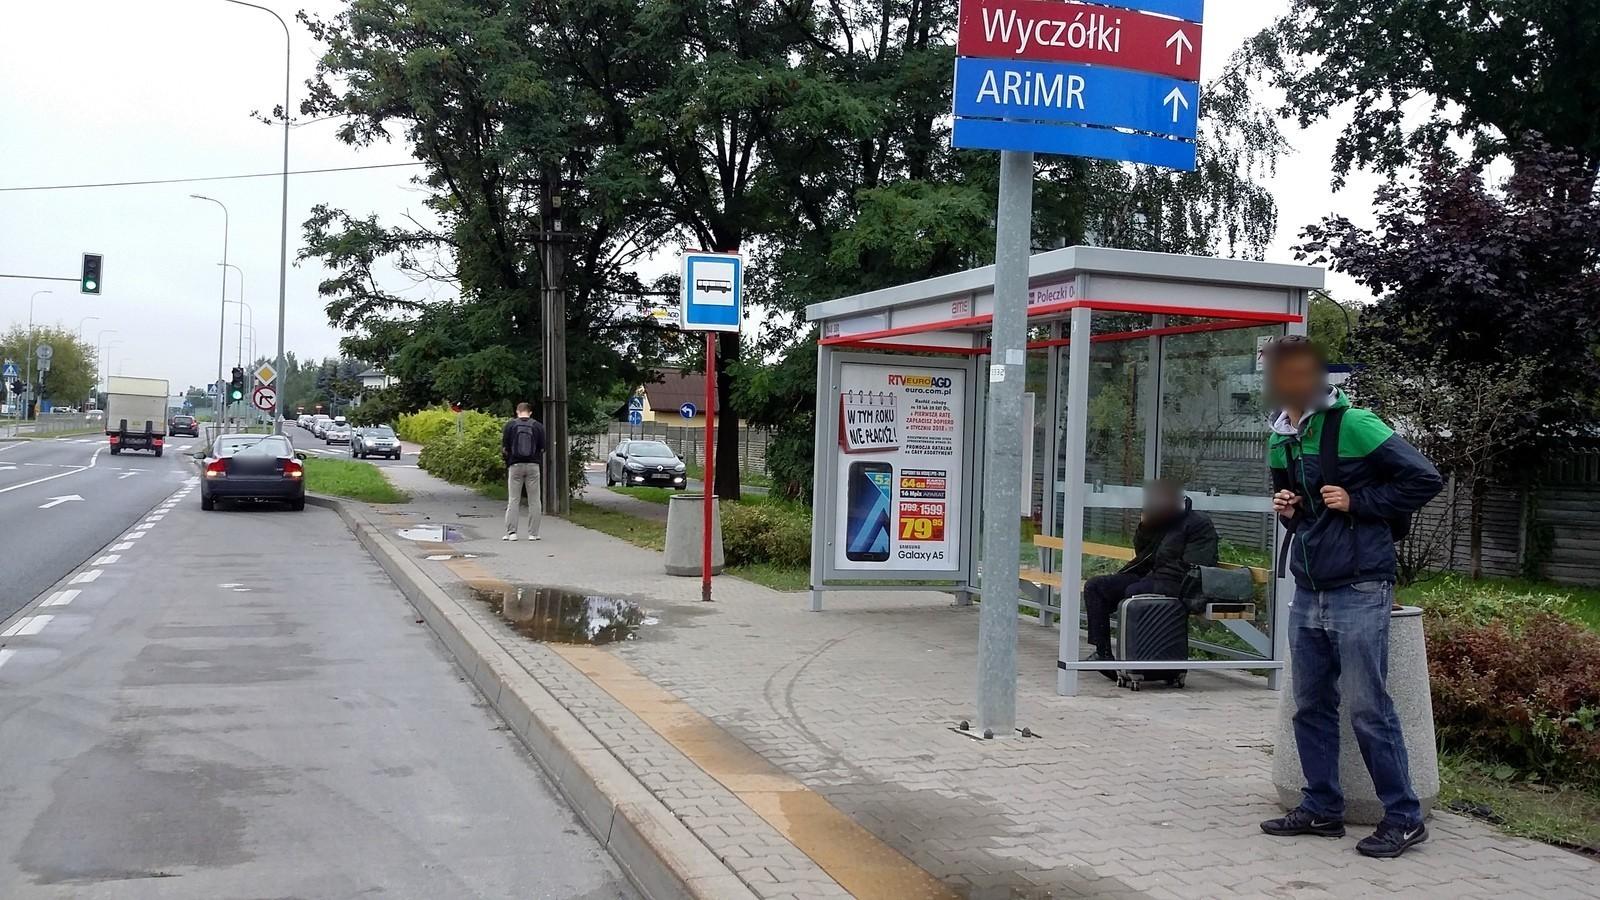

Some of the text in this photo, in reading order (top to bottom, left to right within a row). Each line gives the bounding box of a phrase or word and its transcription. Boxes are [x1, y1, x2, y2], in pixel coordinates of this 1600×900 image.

[981, 7, 1121, 54] Wyczółki
[976, 69, 1086, 110] ARiMR
[1037, 287, 1067, 303] Poleczki
[905, 387, 952, 396] euro.com.pl
[847, 409, 895, 424] W TYM ROKU
[849, 427, 865, 445] NIE
[901, 478, 916, 488] 64
[900, 518, 932, 539] 79
[898, 551, 944, 562] Galaxy A5
